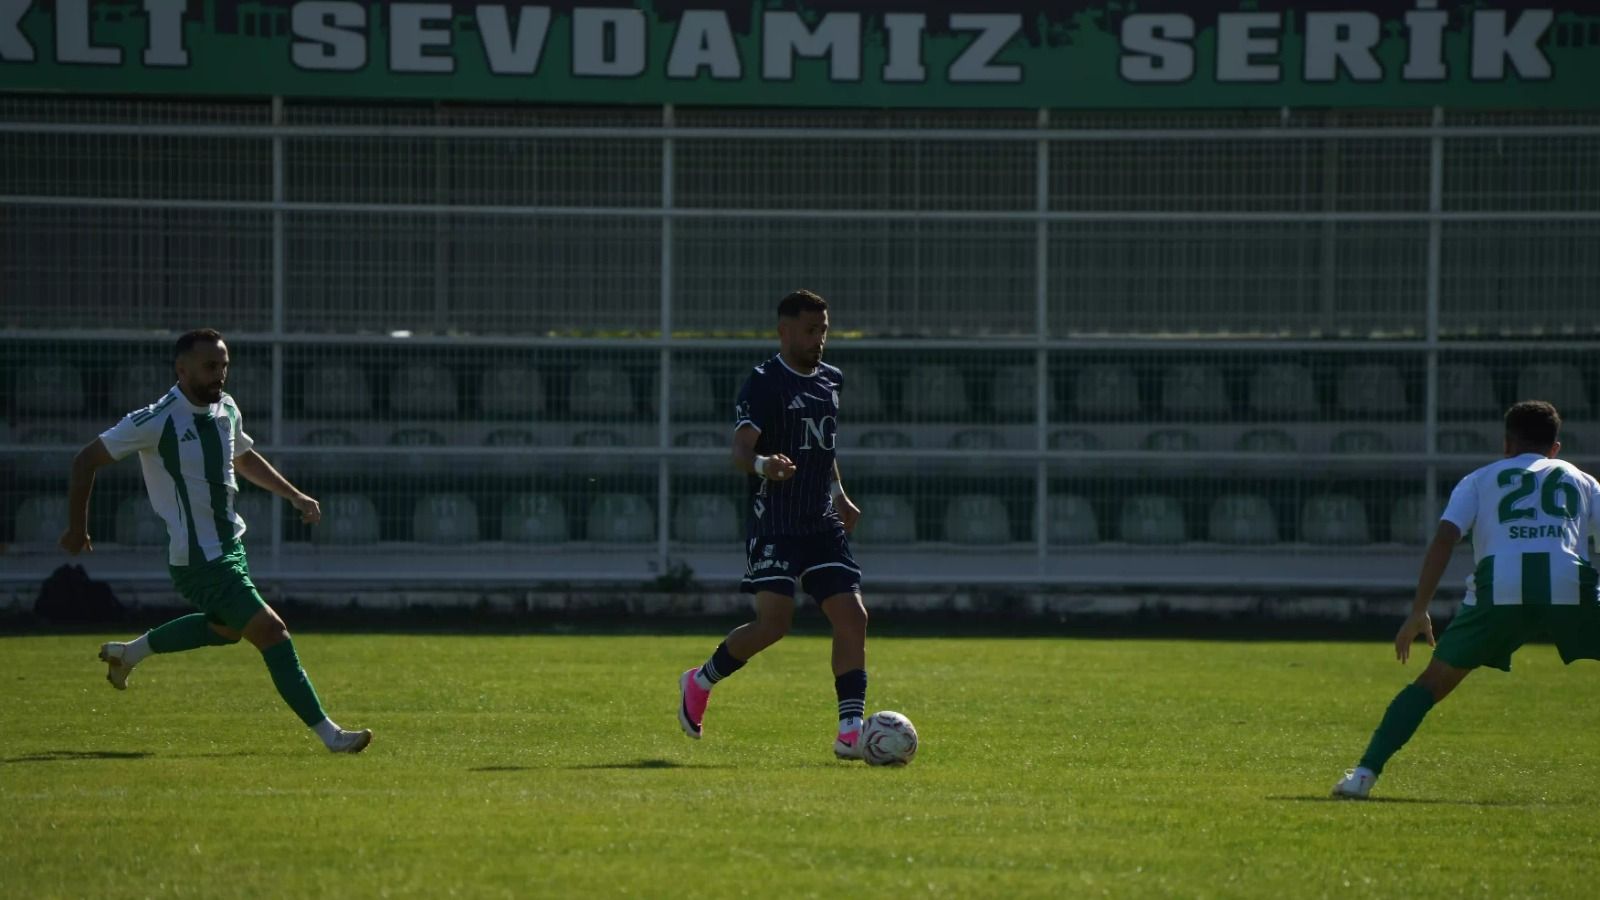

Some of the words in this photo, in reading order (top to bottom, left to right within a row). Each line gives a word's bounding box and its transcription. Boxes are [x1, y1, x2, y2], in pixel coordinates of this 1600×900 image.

[291, 0, 1023, 83] SEVDAMIZ
[1120, 0, 1555, 83] SERİK
[799, 415, 837, 450] NG
[1497, 467, 1580, 524] 26
[1509, 525, 1567, 539] SERTAN
